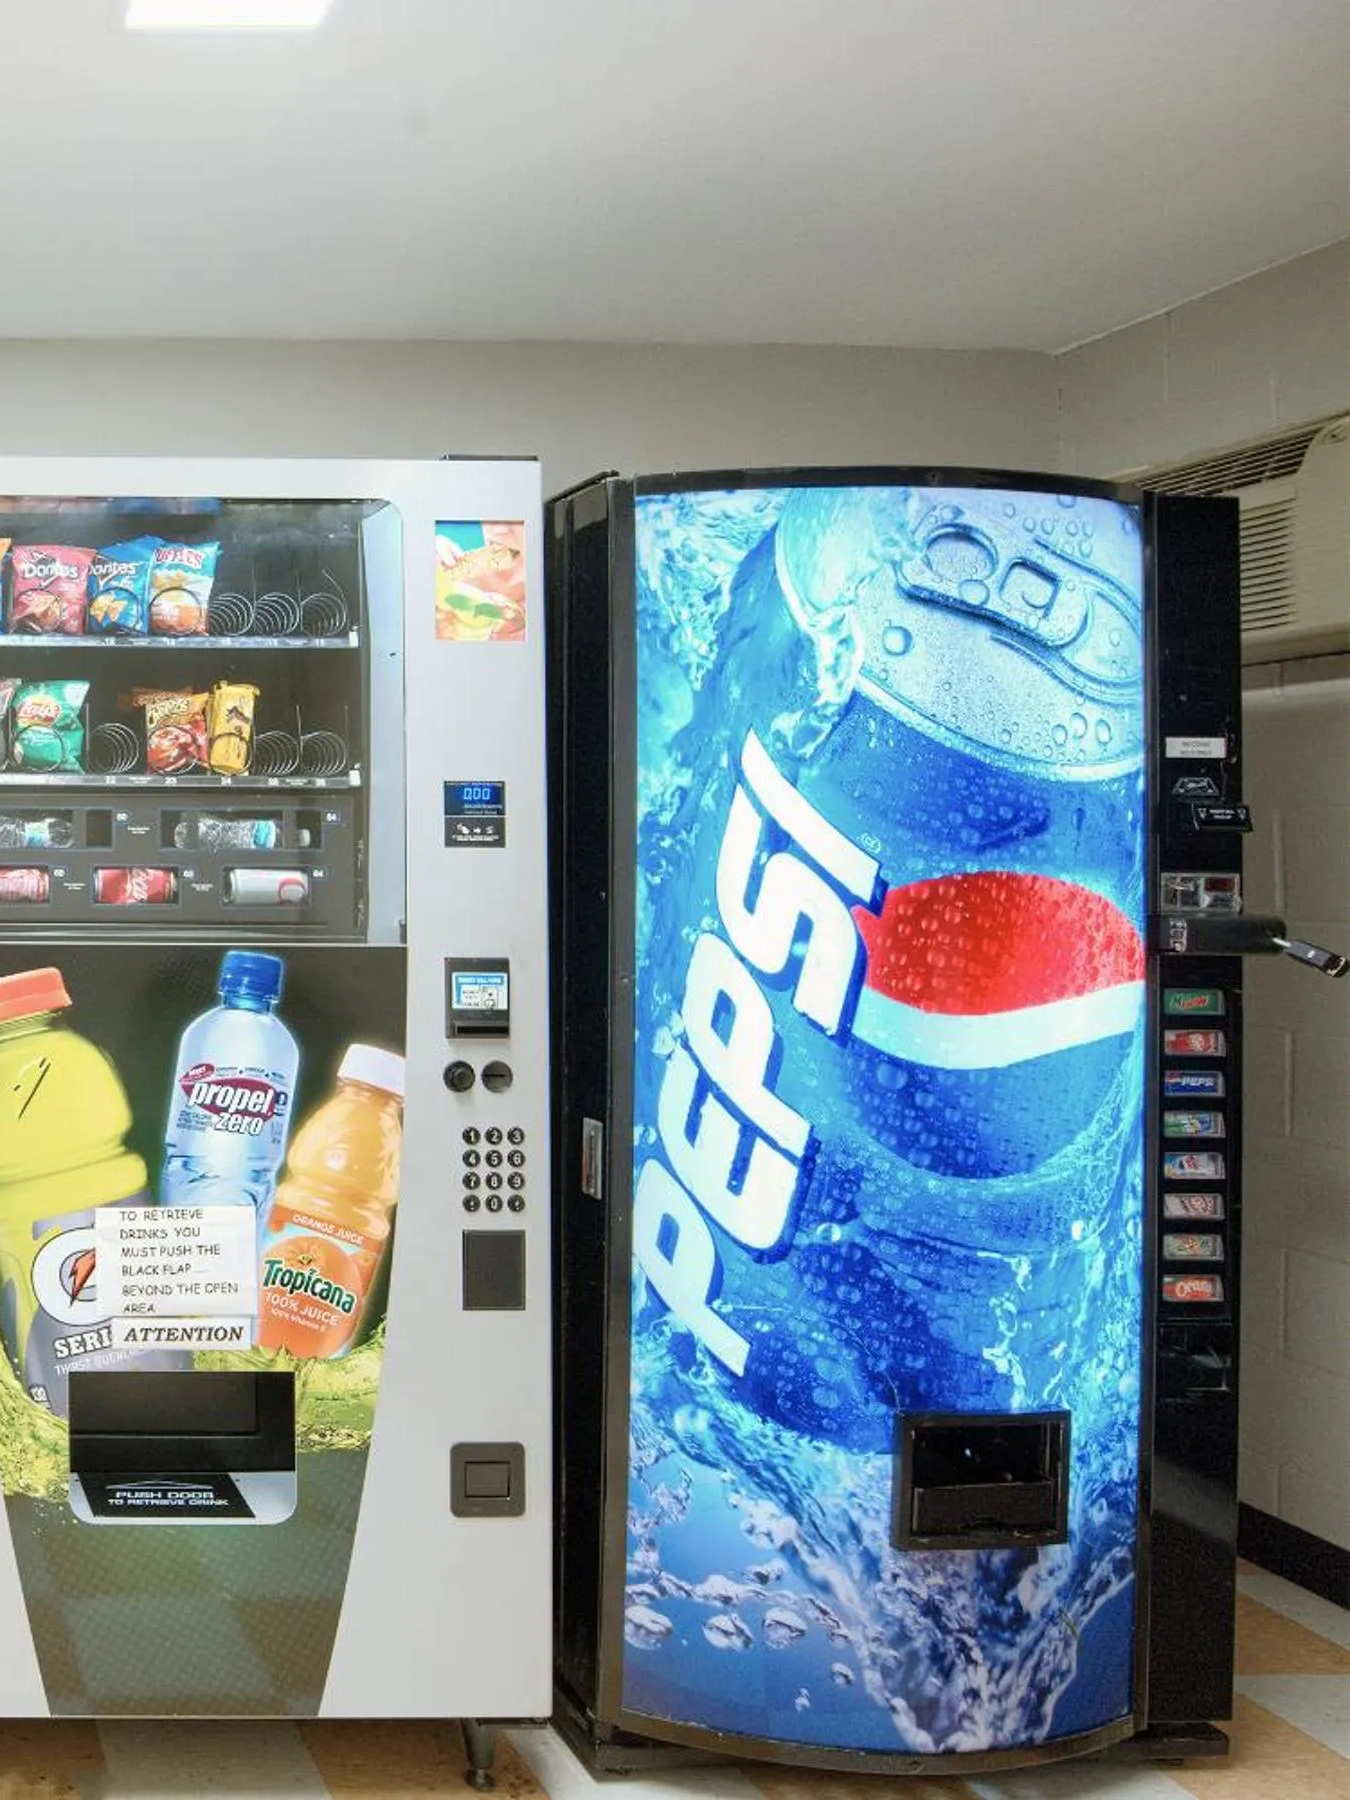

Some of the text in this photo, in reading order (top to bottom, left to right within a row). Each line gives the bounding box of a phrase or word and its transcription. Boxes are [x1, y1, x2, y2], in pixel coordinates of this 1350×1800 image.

[633, 726, 883, 1378] PEPSI
[189, 1082, 275, 1114] propel
[214, 1112, 264, 1136] zero
[119, 1209, 204, 1221] TO RETRIEVE
[120, 1227, 200, 1240] DRINKS YOU
[292, 1213, 365, 1245] ORANGE JUICE
[120, 1243, 221, 1258] MUST PUSH THE
[121, 1263, 192, 1277] BLACK FLAP
[121, 1281, 239, 1297] BEYOND THE OPEN
[262, 1259, 356, 1314] Tropicana
[122, 1302, 156, 1314] AREA
[266, 1292, 340, 1326] 100% JUICE
[53, 1325, 112, 1359] SERI
[123, 1326, 244, 1343] ATTENTION
[107, 1498, 229, 1506] TO RETRIEVE DRINK
[116, 1491, 214, 1499] PUSH DOOR
